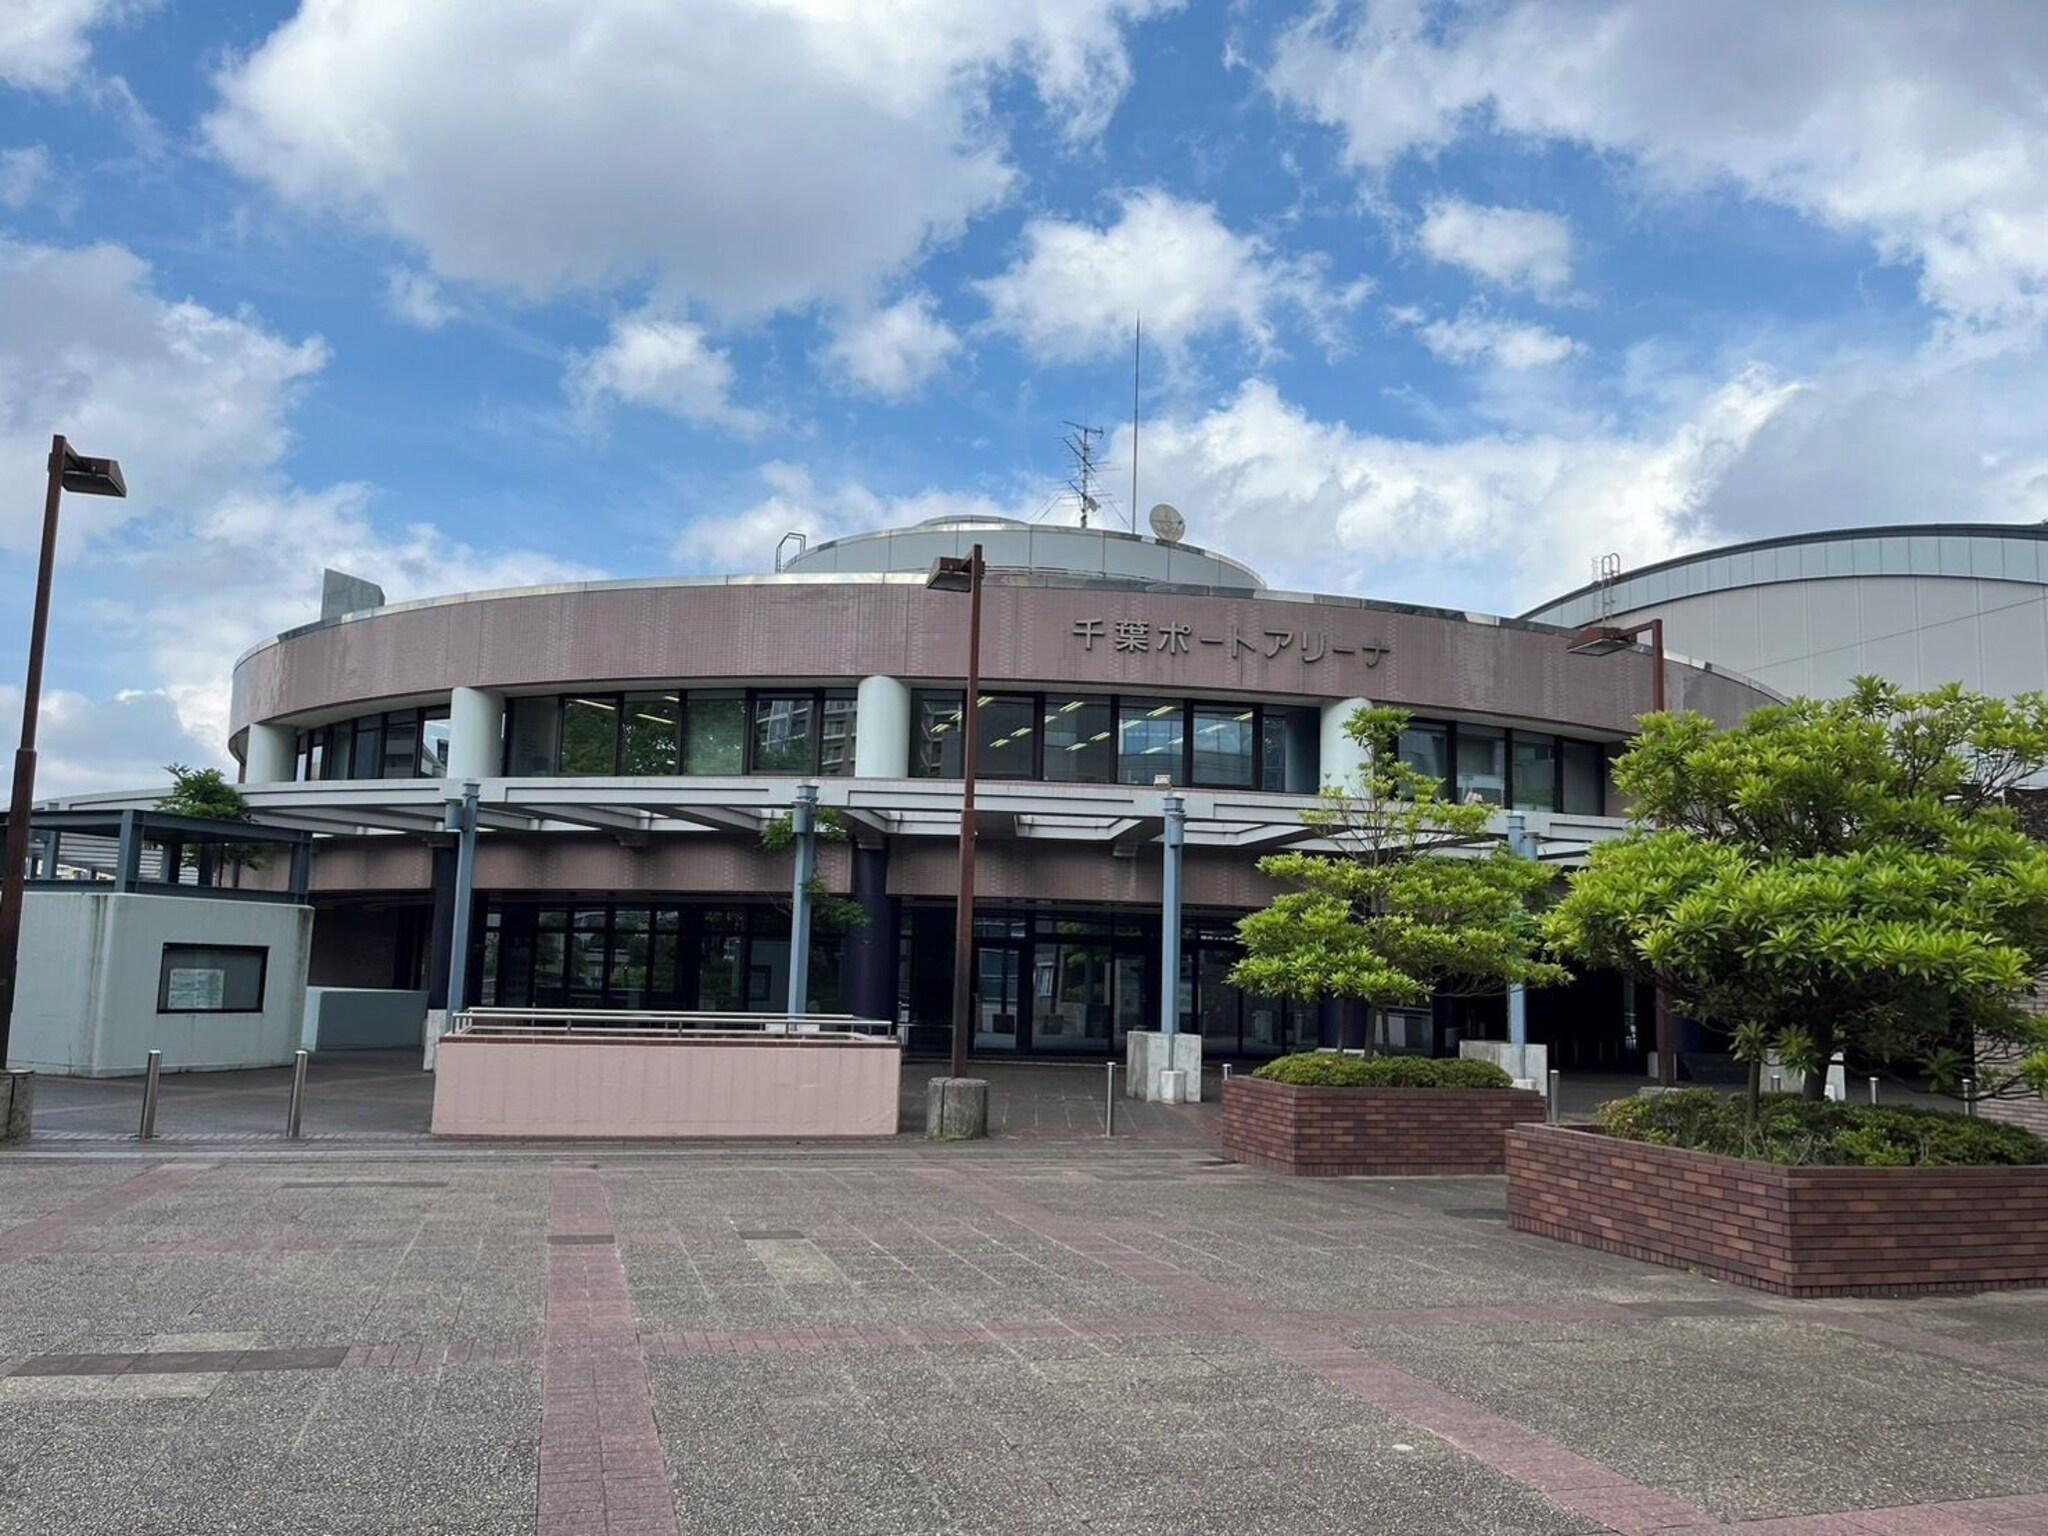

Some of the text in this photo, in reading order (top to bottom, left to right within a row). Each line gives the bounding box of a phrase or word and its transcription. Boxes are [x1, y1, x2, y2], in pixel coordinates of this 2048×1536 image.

[1073, 619, 1390, 667] 千葉ポートアリーナ
